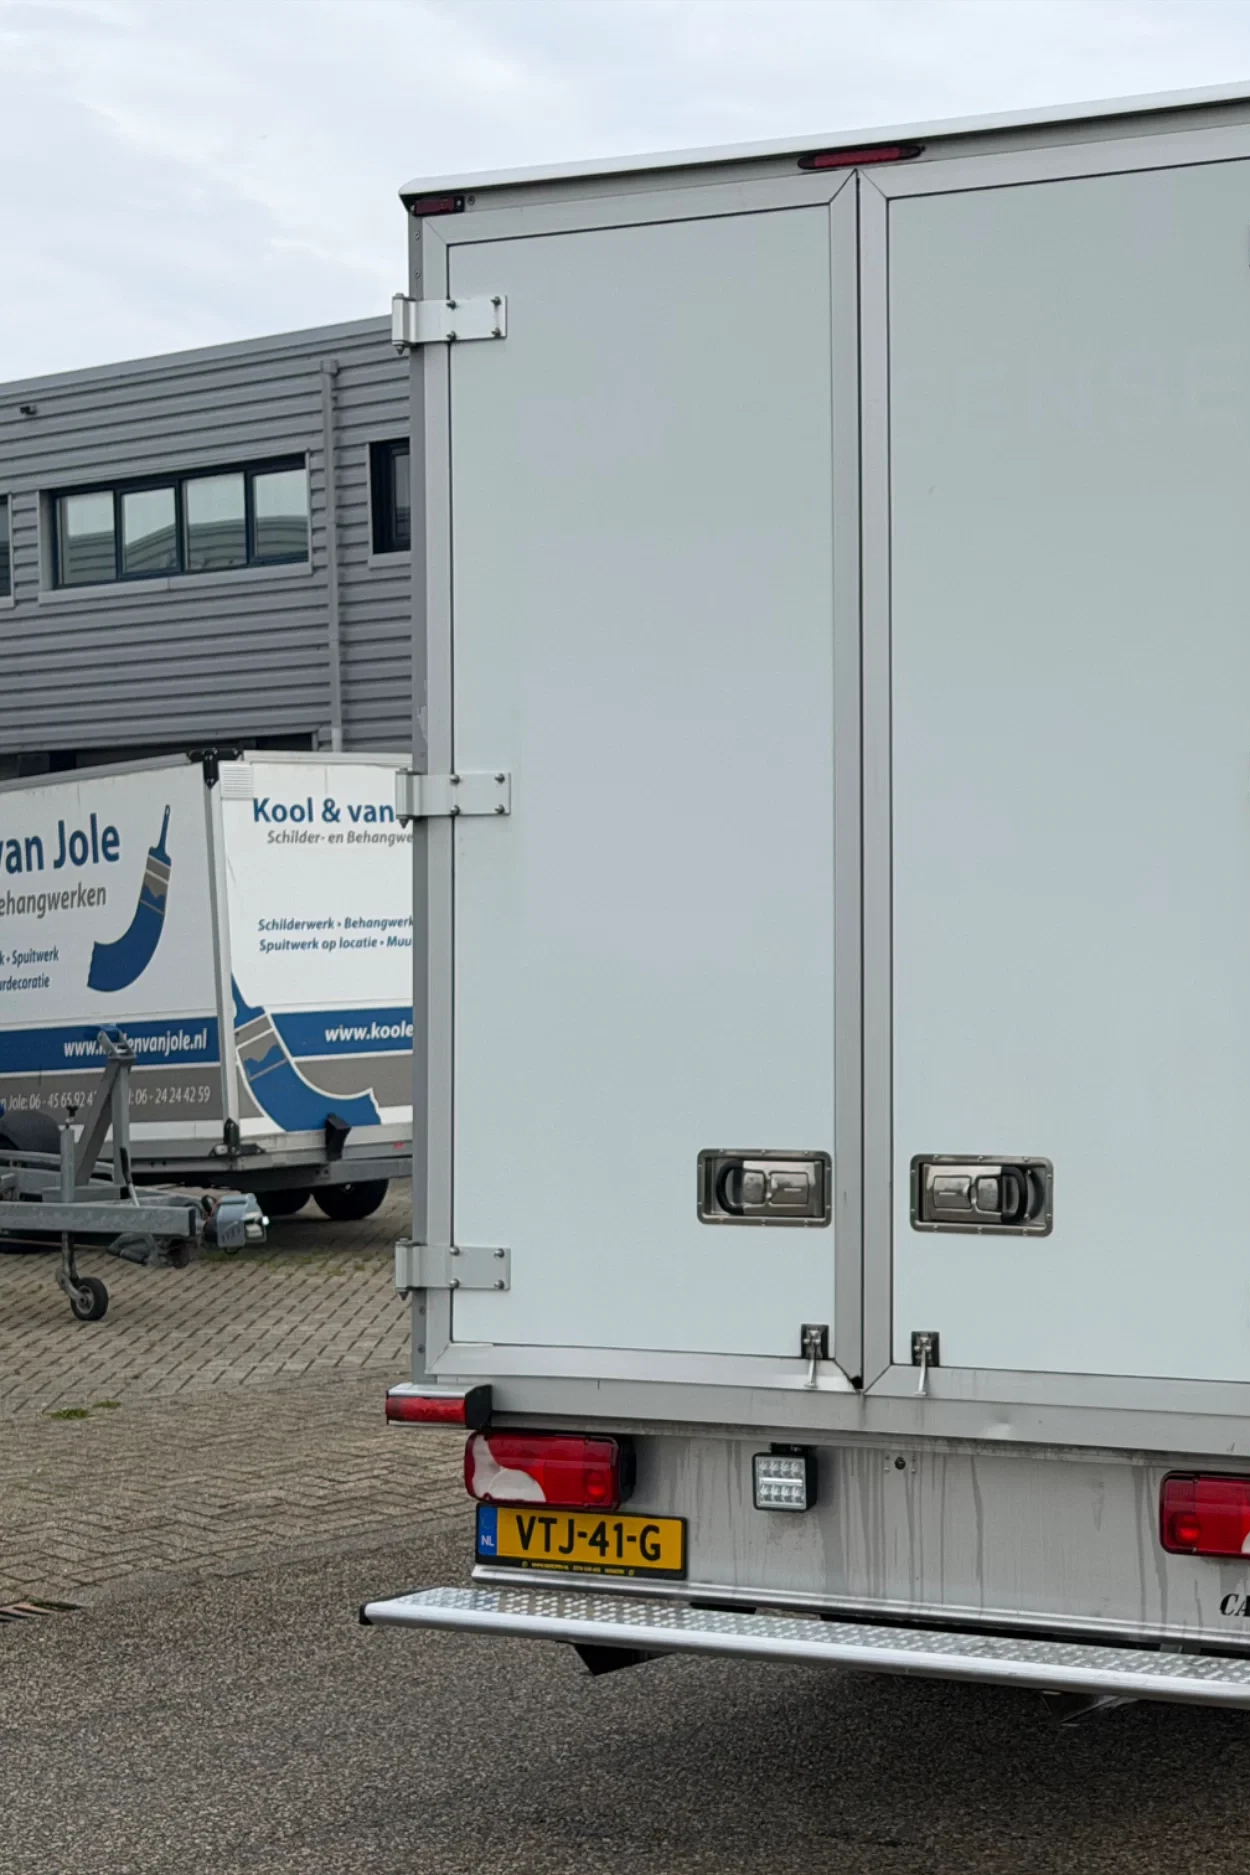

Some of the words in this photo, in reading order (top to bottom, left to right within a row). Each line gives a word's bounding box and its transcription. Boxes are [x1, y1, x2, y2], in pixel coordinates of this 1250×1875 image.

[253, 797, 313, 823] Kool
[321, 798, 341, 823] &
[347, 804, 394, 823] van
[0, 836, 44, 874] an
[53, 813, 120, 869] Jole
[267, 830, 325, 844] Schilder-
[328, 834, 344, 844] en
[258, 917, 334, 932] Schilderwerk
[12, 944, 59, 968] Spuitwerk
[259, 937, 319, 954] Spuitwerk
[321, 940, 337, 952] op
[339, 935, 377, 949] locatie
[64, 1028, 207, 1057] www.envanjole.nl
[324, 1020, 413, 1042] www.koole
[481, 1535, 494, 1546] NL
[516, 1514, 661, 1562] VTJ-41-G
